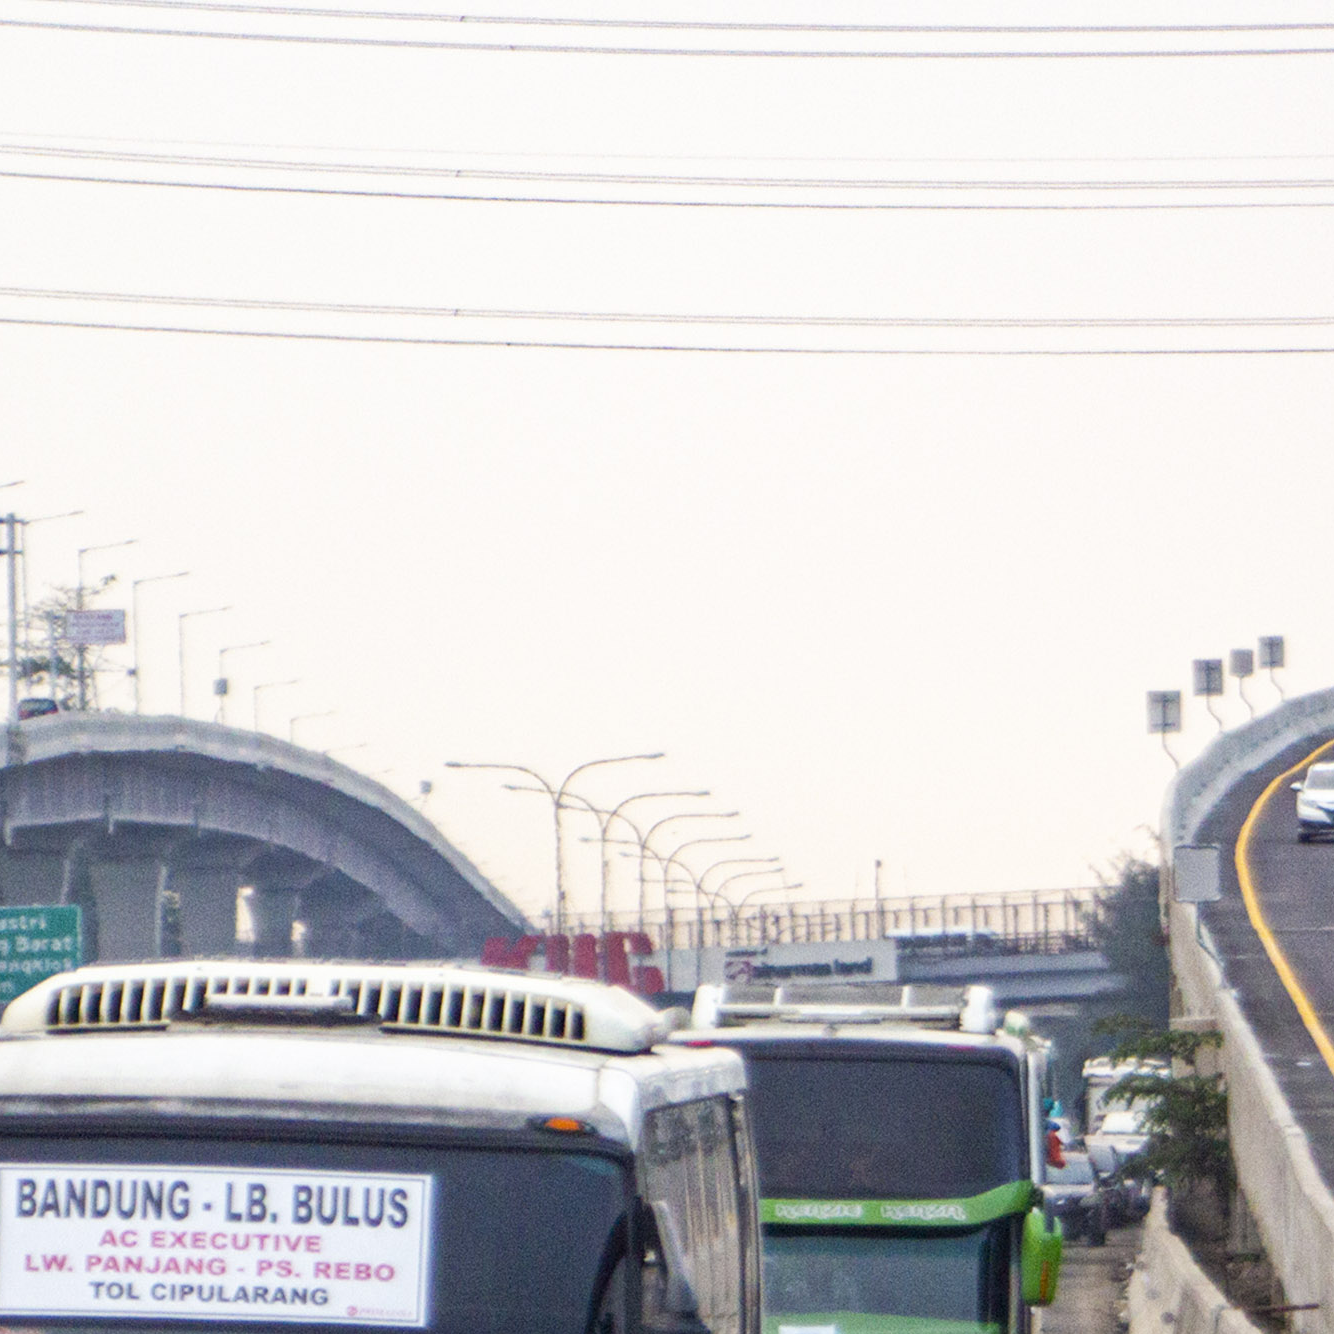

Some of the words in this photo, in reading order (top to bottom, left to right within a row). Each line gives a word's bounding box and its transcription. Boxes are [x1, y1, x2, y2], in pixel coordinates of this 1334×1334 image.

[16, 936, 72, 952] Barat
[16, 1178, 191, 1221] BANDUNG
[225, 1182, 278, 1224] LB.
[291, 1184, 409, 1229] BULUS
[98, 1230, 138, 1248] AC
[151, 1231, 322, 1253] EXECUTIVE
[24, 1254, 73, 1273] LW.
[85, 1254, 227, 1277] PANJANG
[256, 1259, 301, 1279] PS.
[313, 1261, 396, 1282] REBO
[88, 1281, 141, 1301] TOL
[150, 1283, 329, 1306] CIPULARANG
